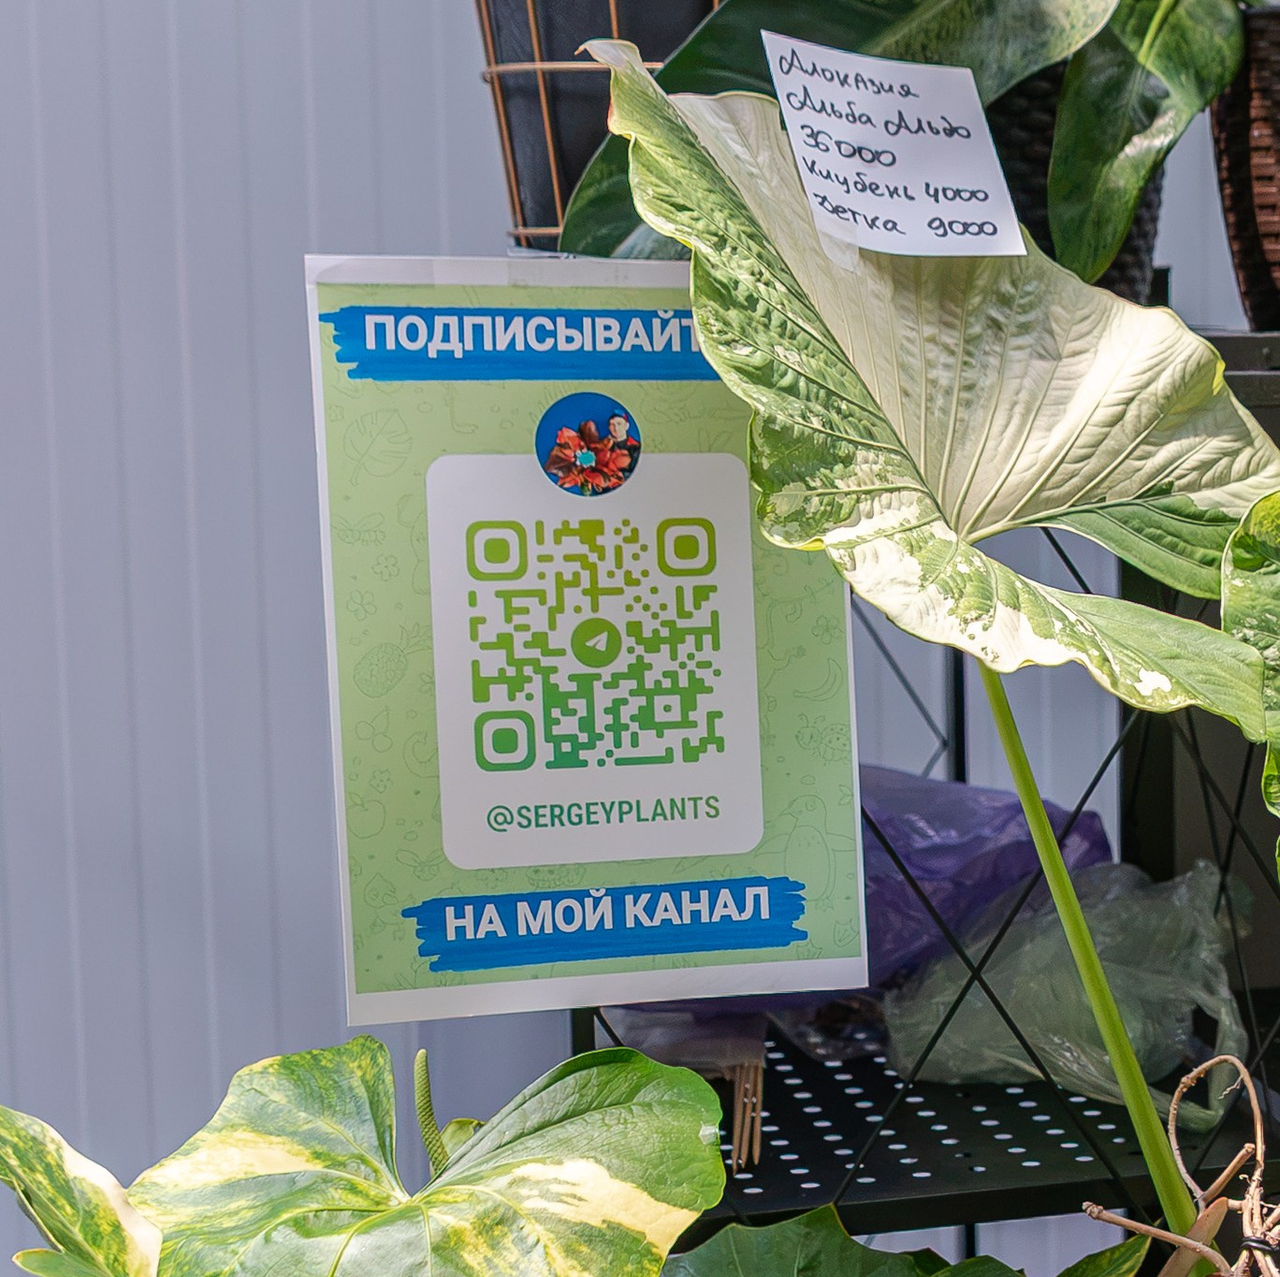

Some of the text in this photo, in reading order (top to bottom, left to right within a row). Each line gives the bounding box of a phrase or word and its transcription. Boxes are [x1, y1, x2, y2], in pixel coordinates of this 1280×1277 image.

[925, 182, 989, 204] 4000
[927, 217, 998, 237] 9000
[487, 795, 720, 832] @SERGEYPLANTS
[445, 886, 770, 941] НА МОЙ КАНАЛ
